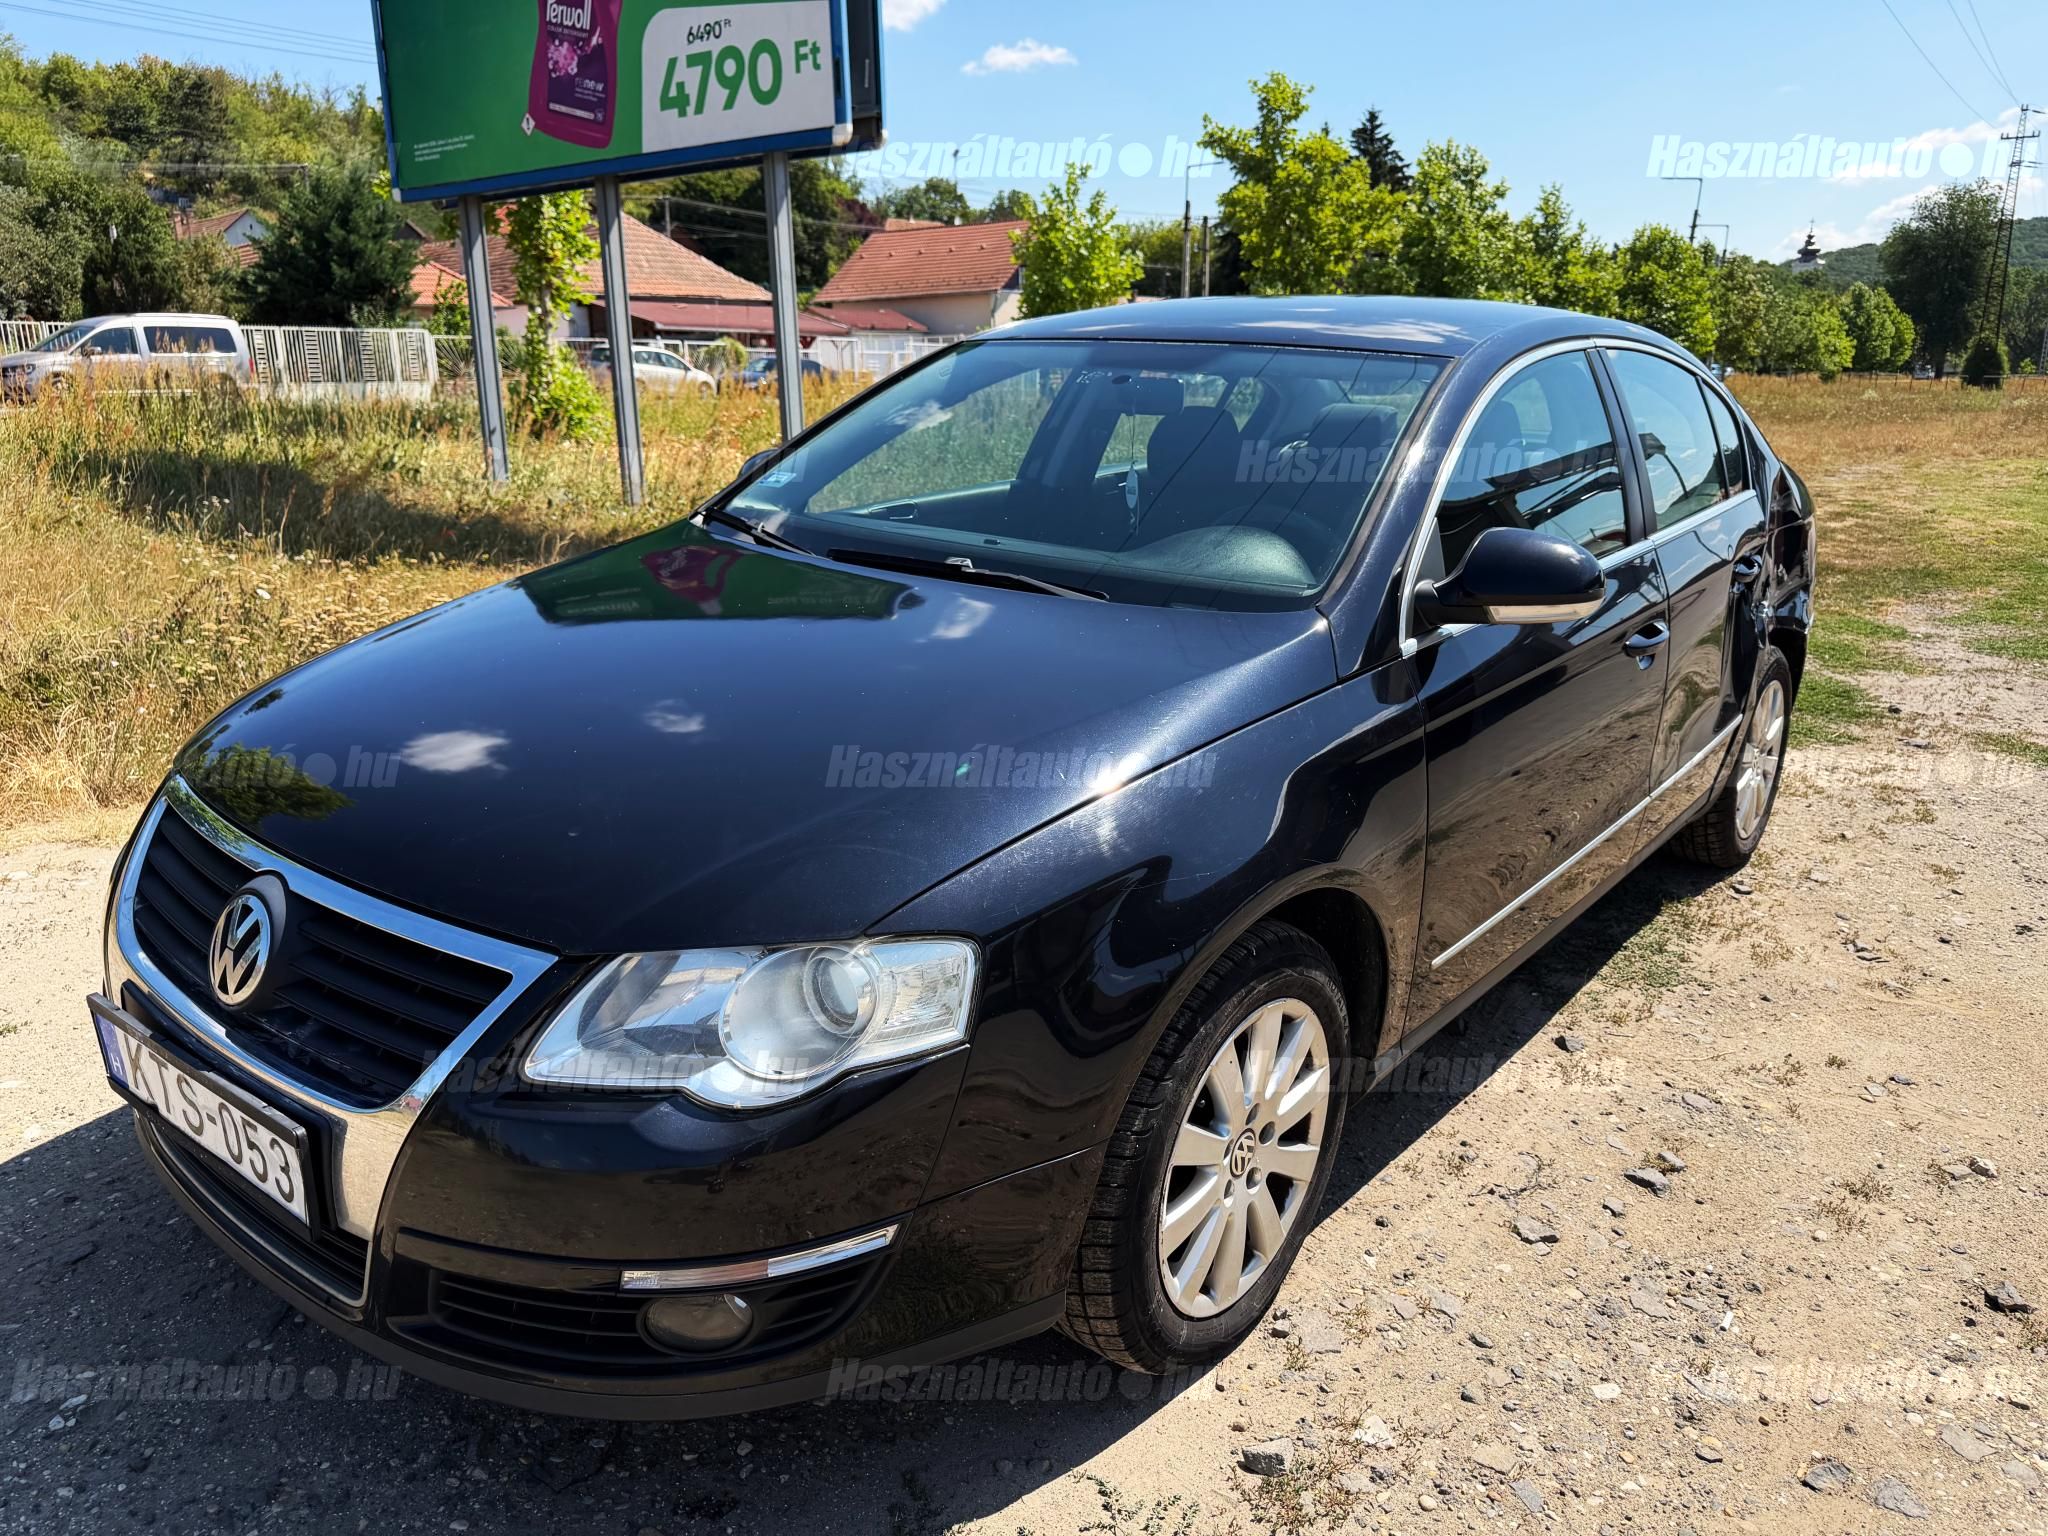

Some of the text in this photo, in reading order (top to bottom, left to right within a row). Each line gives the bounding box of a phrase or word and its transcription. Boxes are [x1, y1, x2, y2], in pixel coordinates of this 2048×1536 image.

[687, 18, 732, 46] 6490 Ft
[659, 38, 822, 118] 4790 Ft
[123, 1034, 295, 1204] KTS-053
